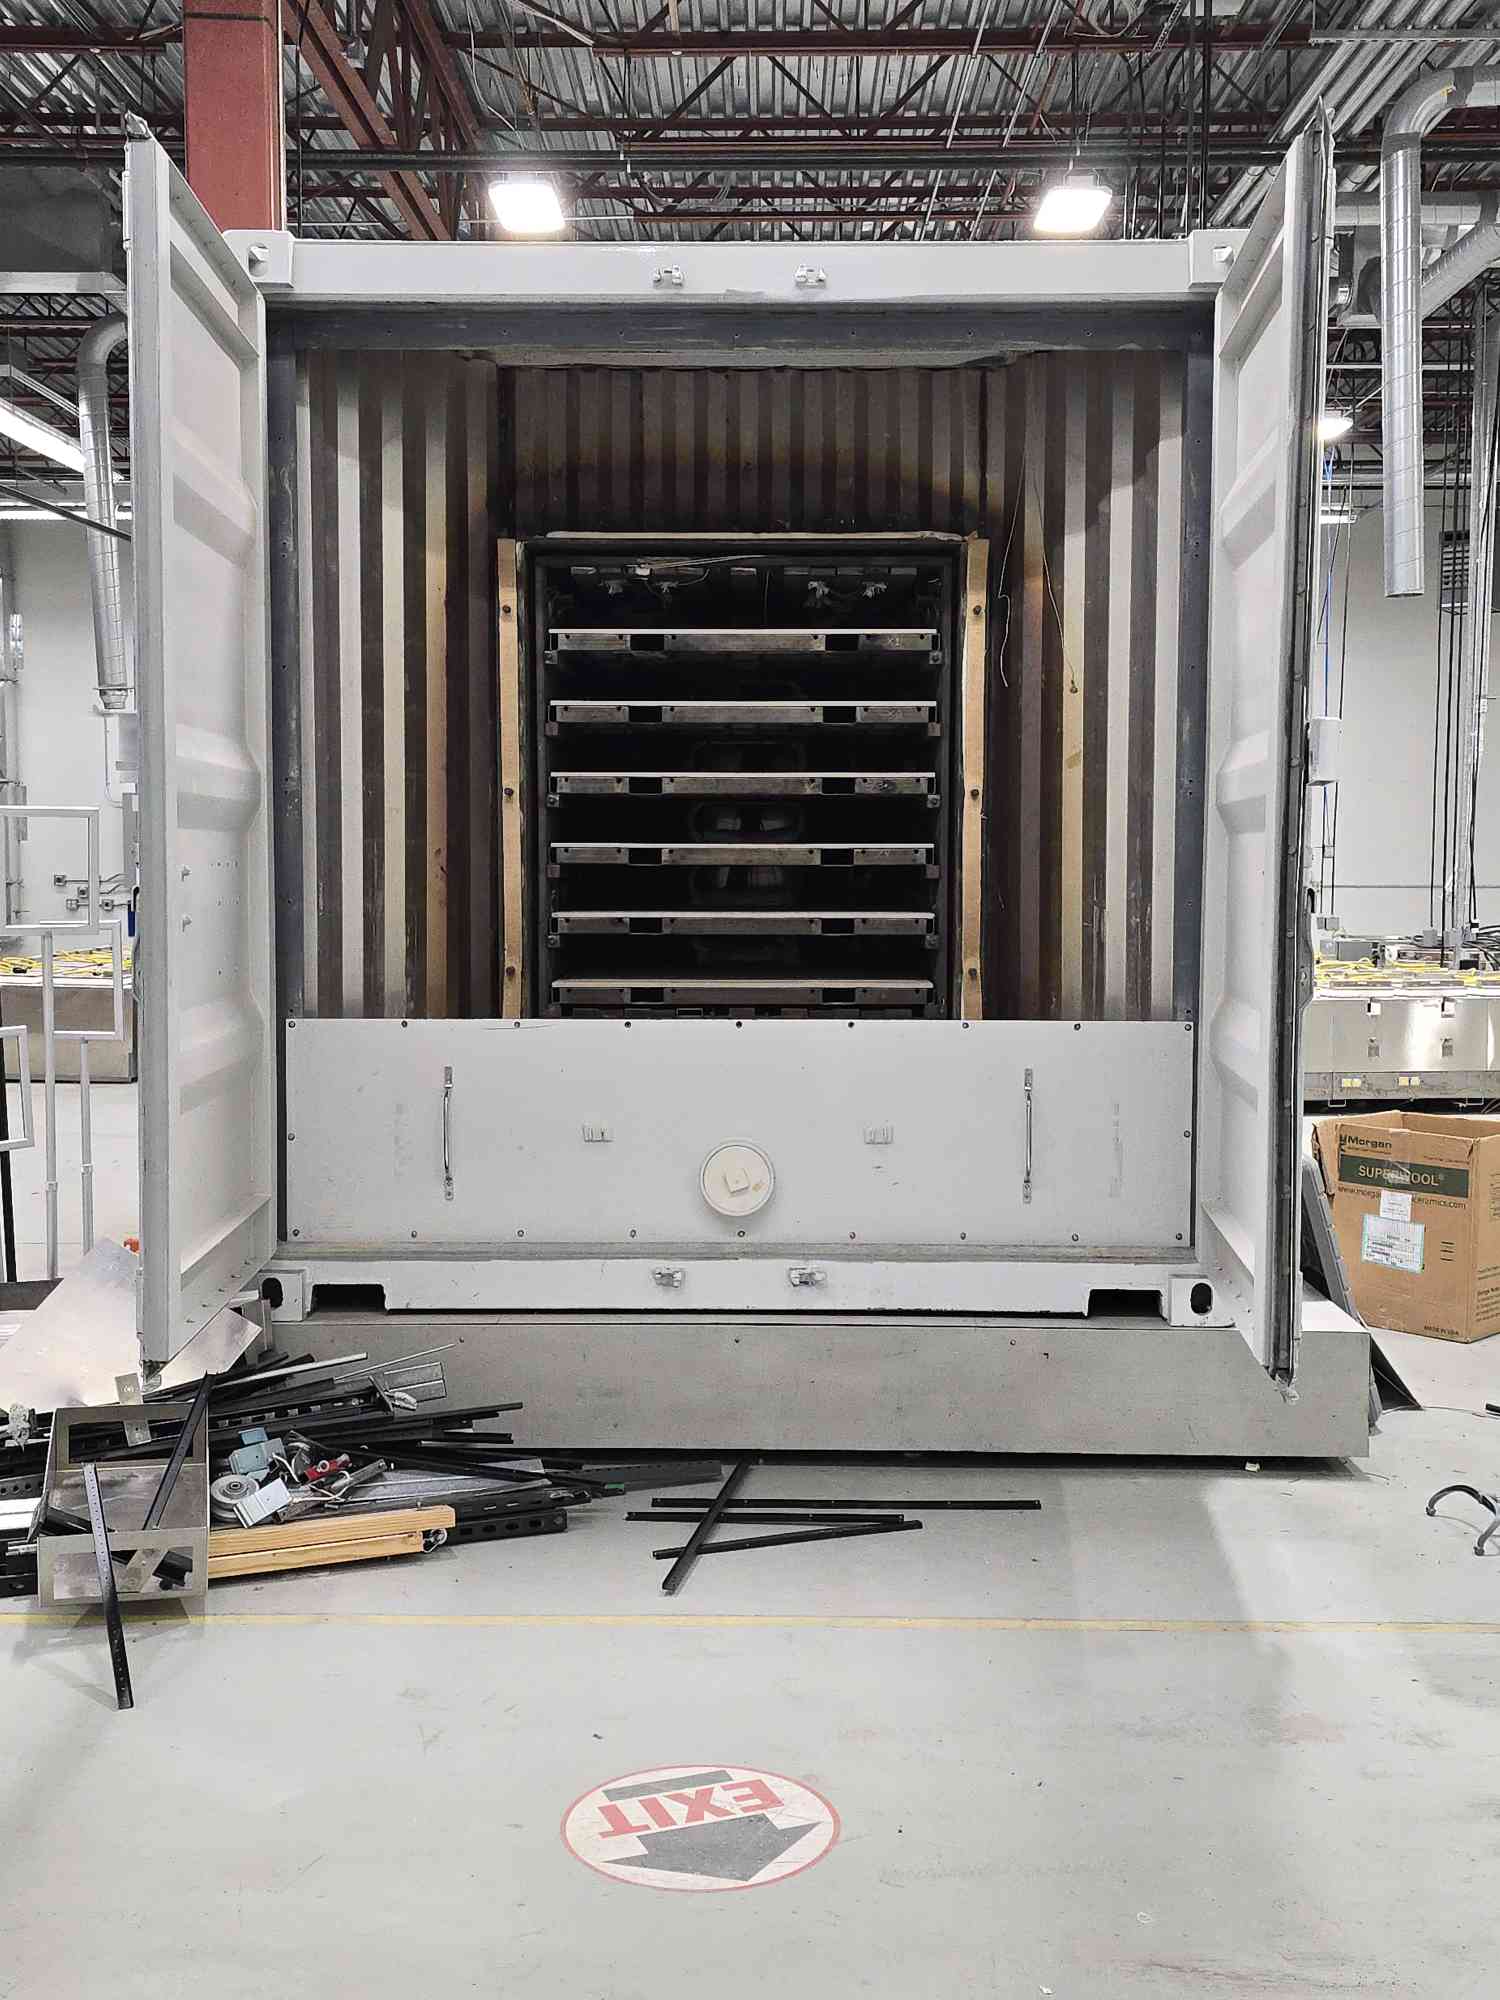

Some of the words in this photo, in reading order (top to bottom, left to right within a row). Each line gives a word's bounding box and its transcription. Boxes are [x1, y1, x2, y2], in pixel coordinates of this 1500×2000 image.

[1347, 1135, 1392, 1149] Morgan
[1359, 1165, 1440, 1186] SUPEOOL
[597, 1778, 785, 1839] EXIT
